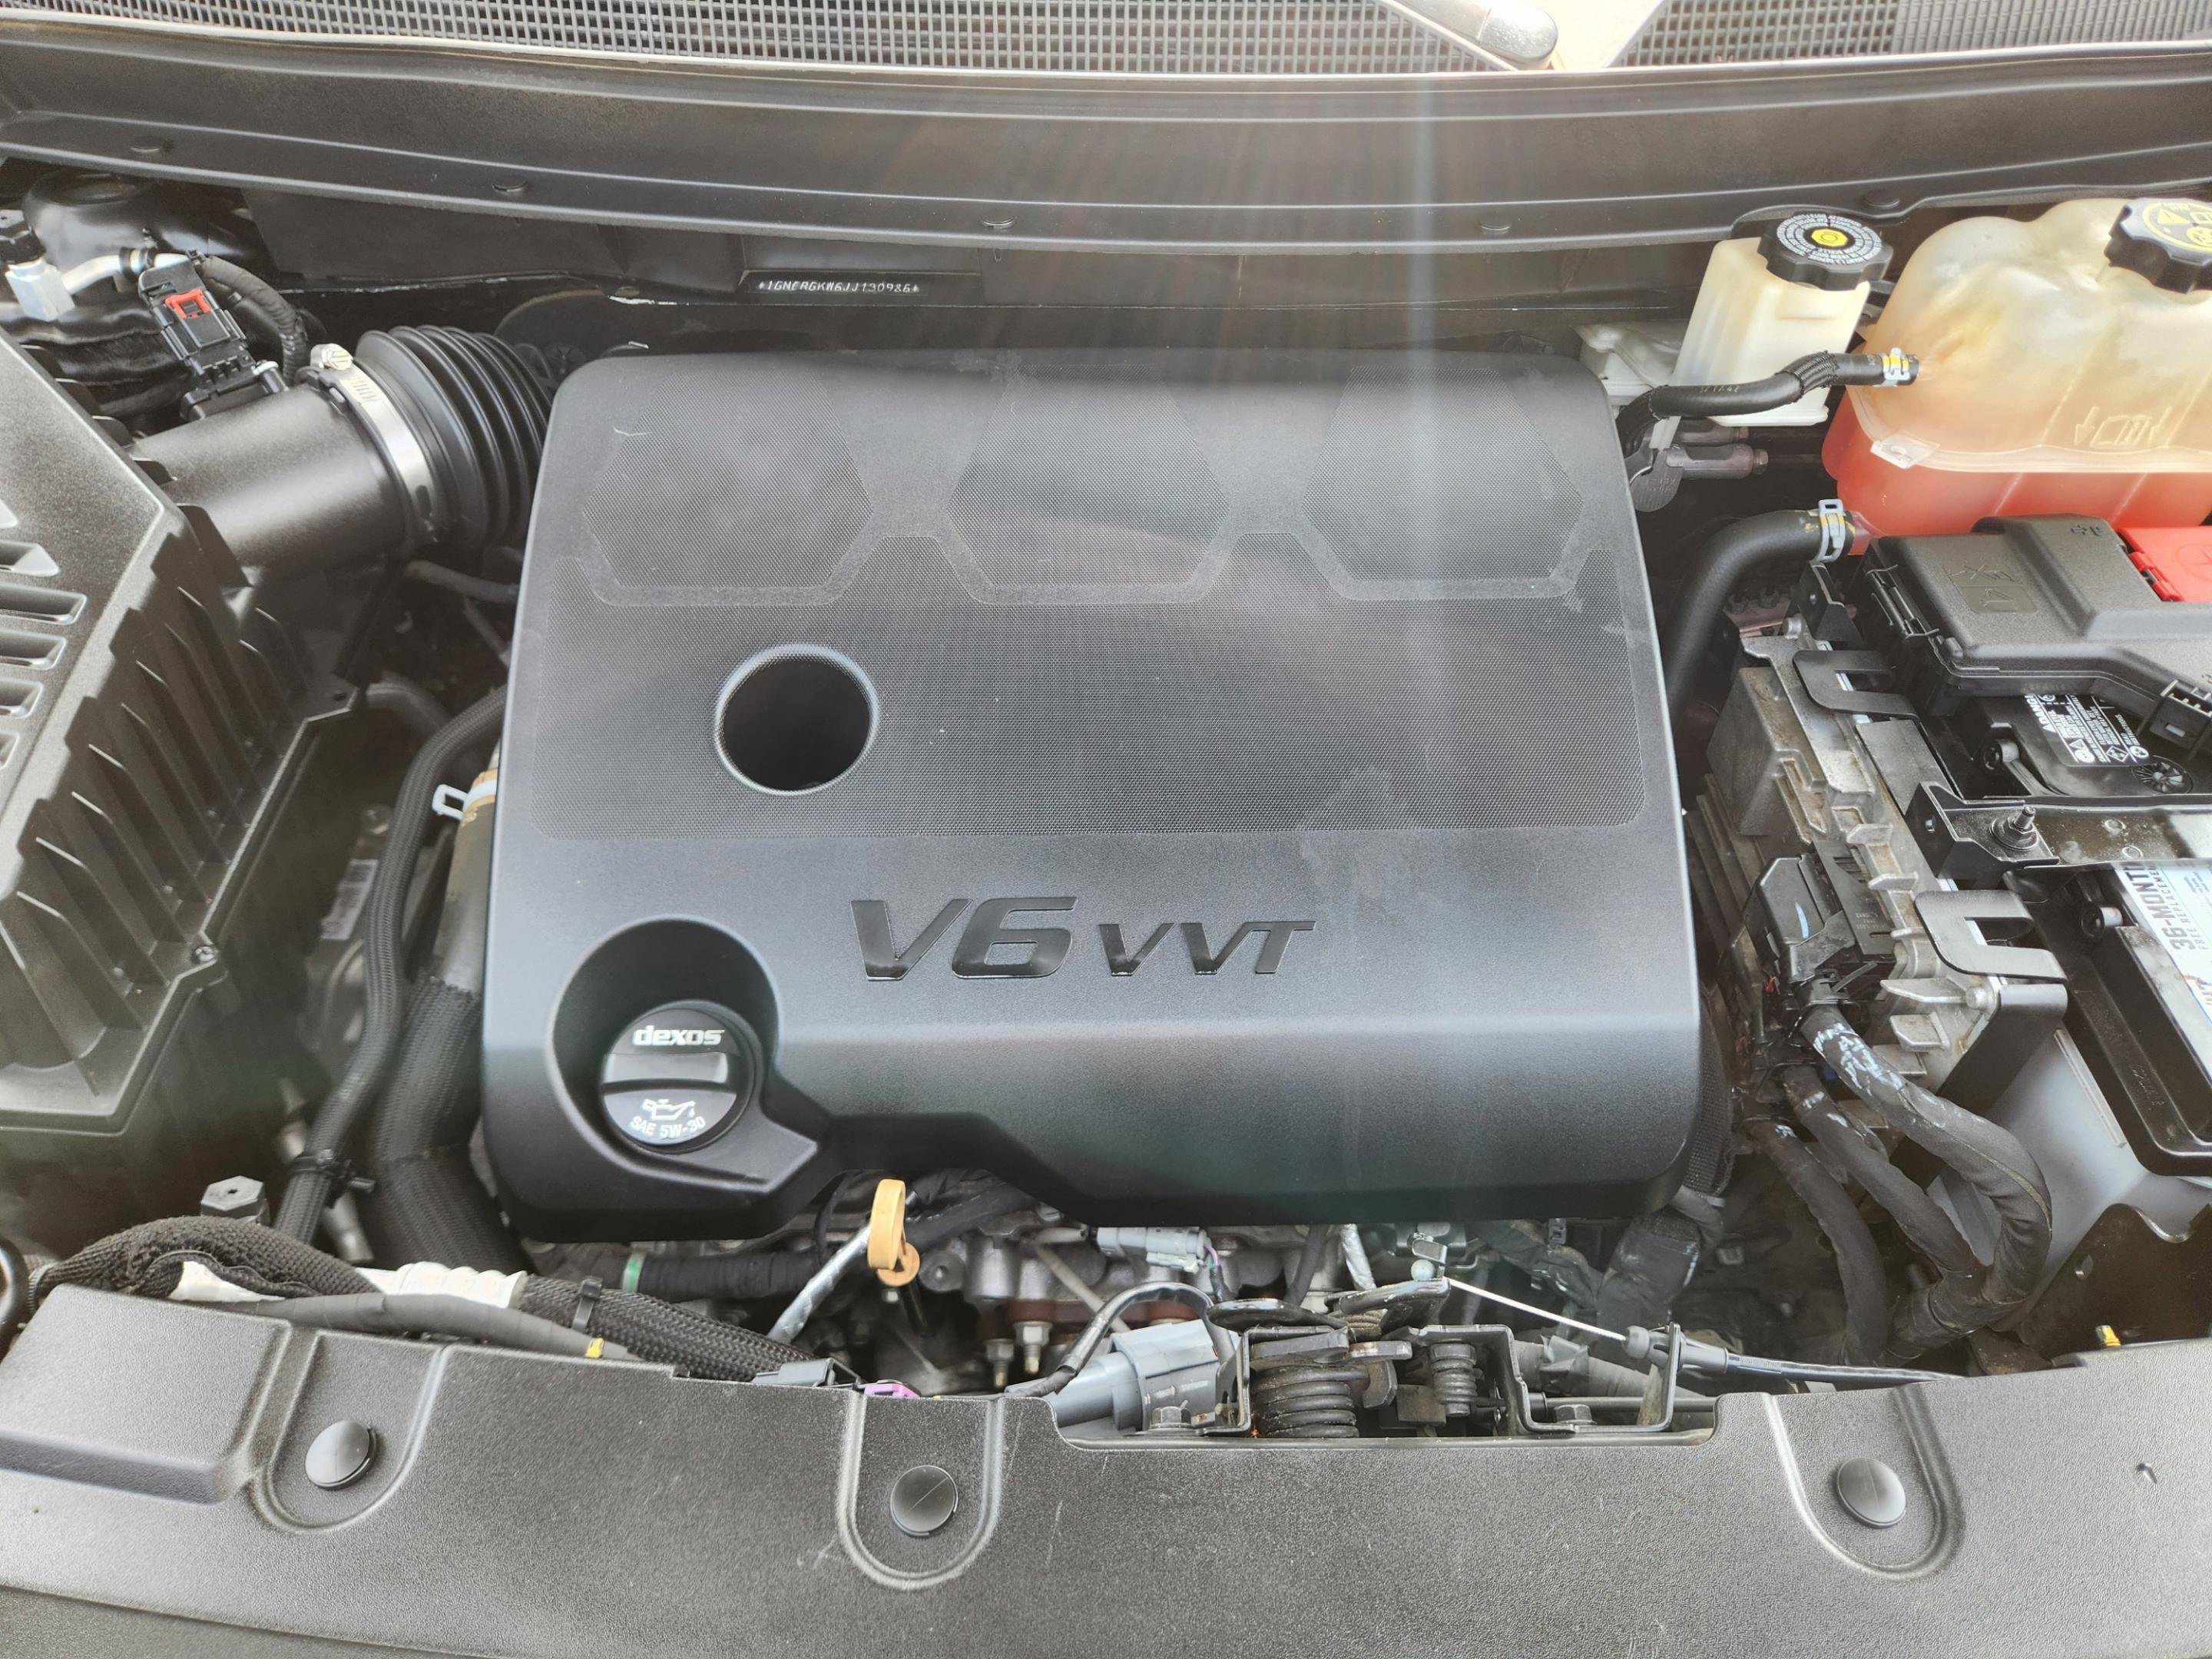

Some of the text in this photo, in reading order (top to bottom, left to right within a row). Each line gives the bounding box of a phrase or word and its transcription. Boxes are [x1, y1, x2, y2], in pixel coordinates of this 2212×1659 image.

[850, 896, 1316, 981] V6 VVT
[634, 1025, 723, 1046] dexos
[631, 1116, 706, 1139] SAE 5W-30
